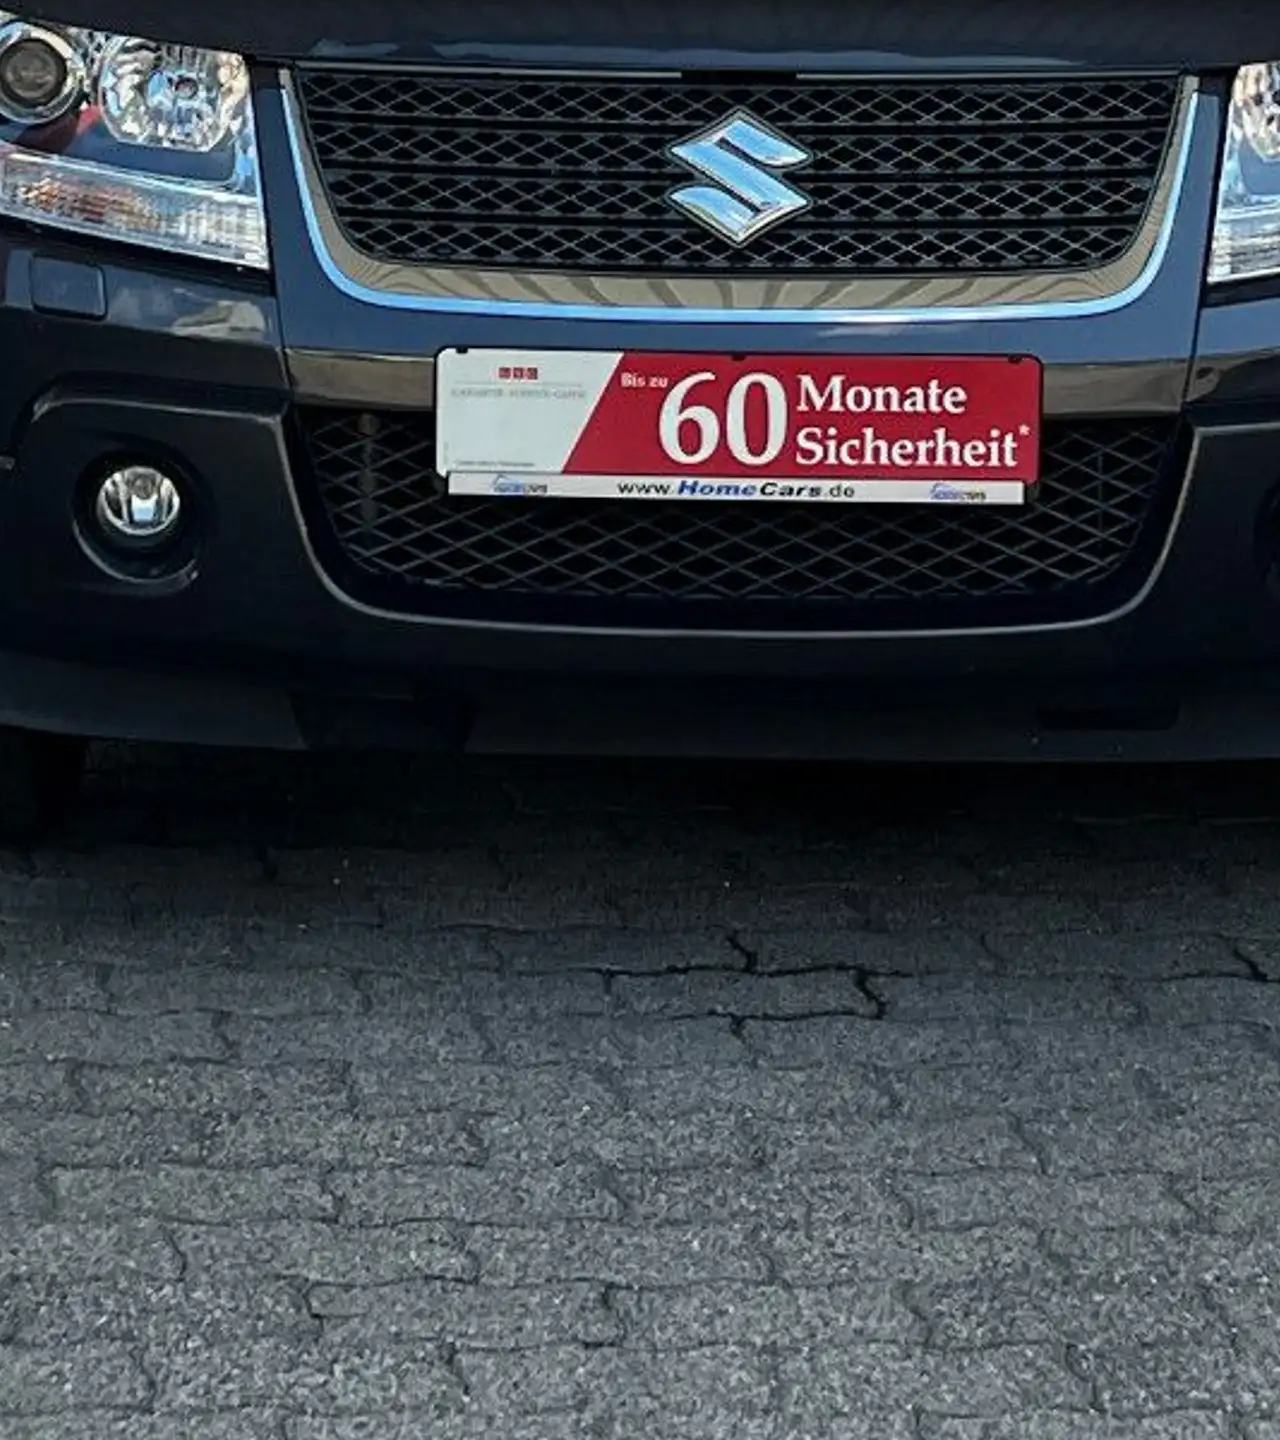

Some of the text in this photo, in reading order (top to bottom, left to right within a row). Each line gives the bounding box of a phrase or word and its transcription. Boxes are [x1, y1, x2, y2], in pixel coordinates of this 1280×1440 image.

[620, 371, 968, 466] Bis zu 60 Monate
